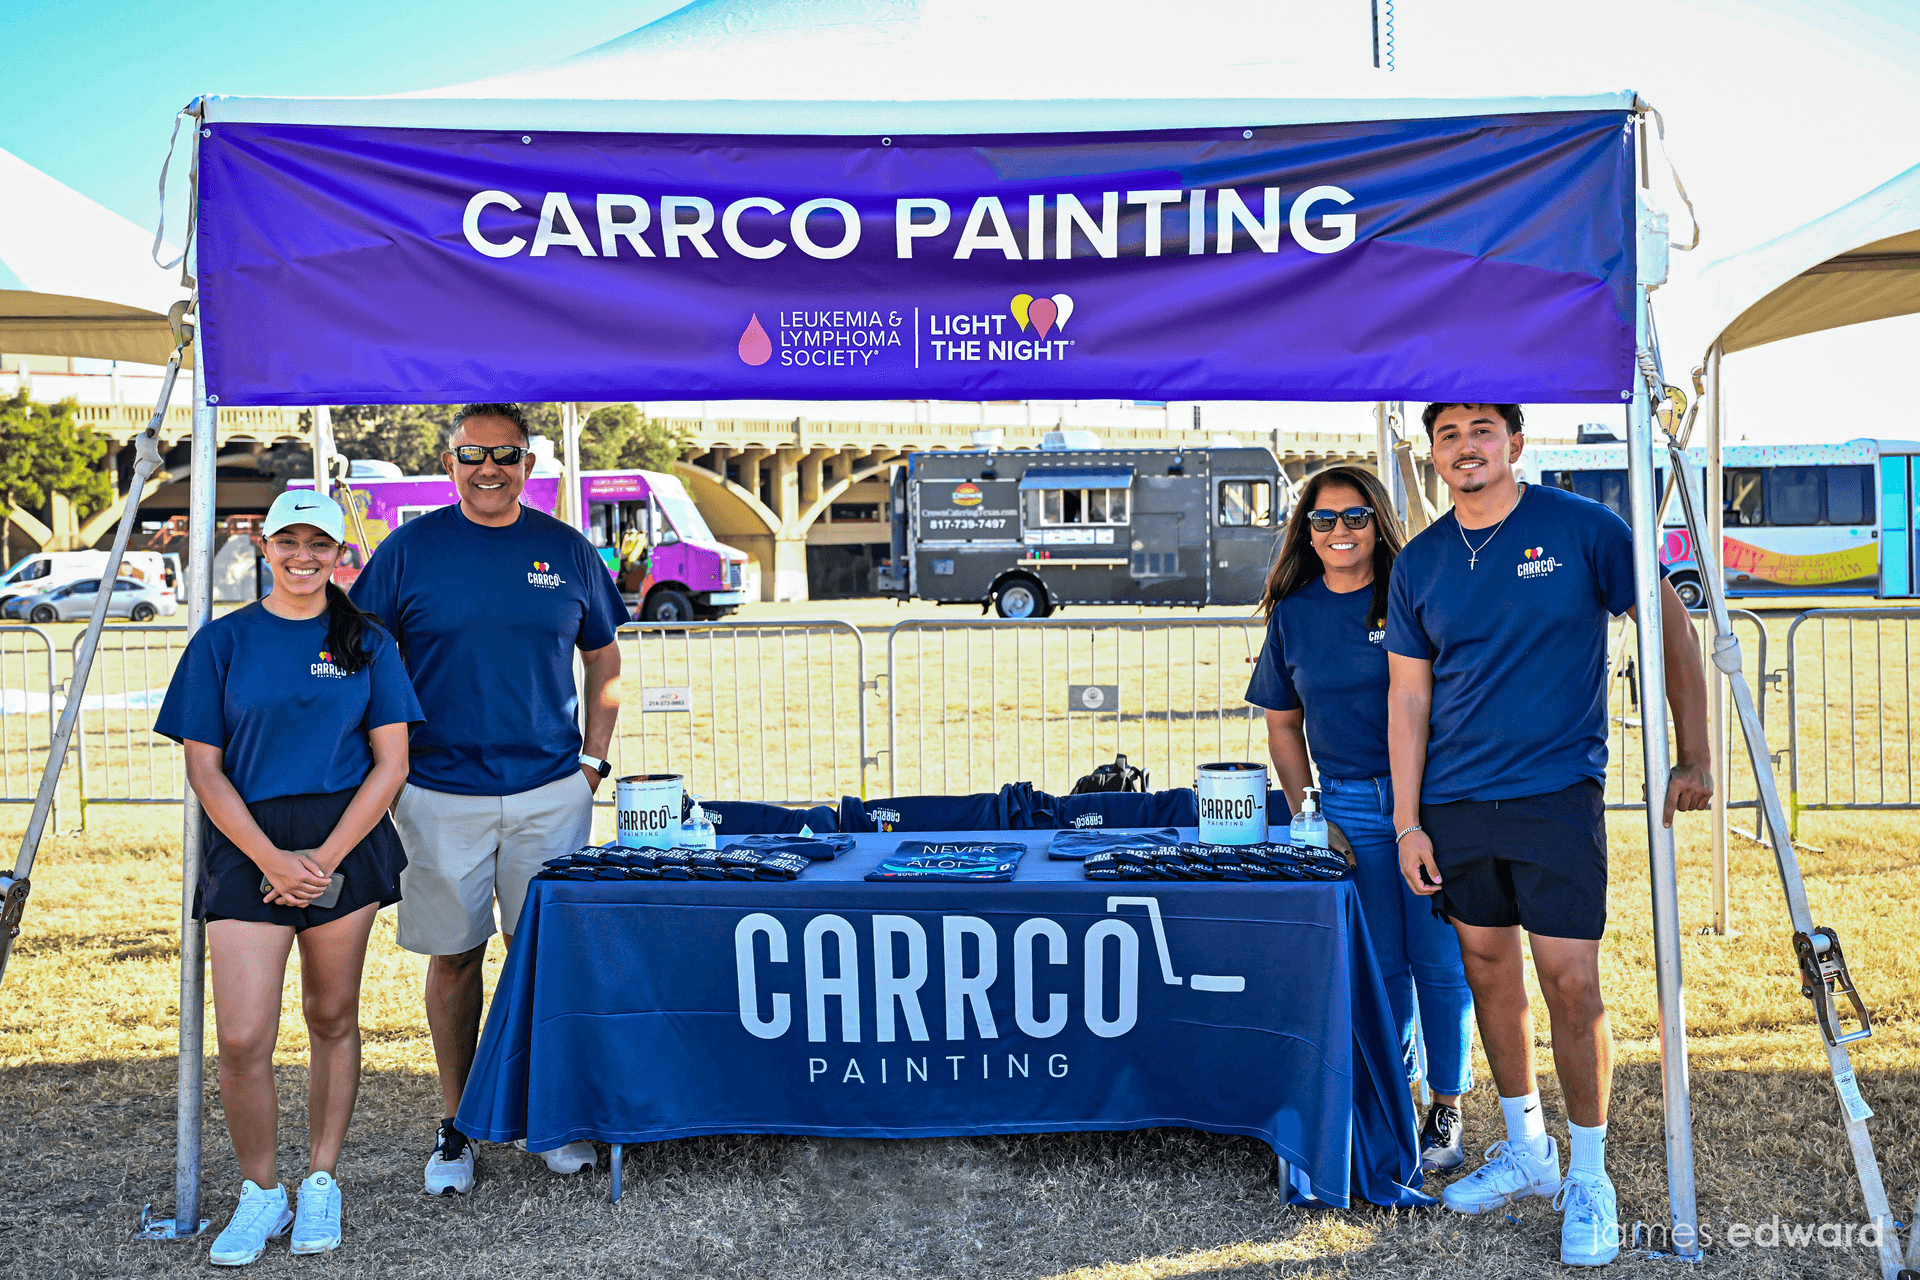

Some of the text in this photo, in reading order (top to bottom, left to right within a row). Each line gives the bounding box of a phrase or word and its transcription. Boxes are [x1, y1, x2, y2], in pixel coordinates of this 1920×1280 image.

[462, 185, 1357, 260] CARRCO PAINTING
[780, 311, 902, 328] LEUKEMIA &
[930, 314, 1007, 335] LIGHT
[780, 330, 902, 347] LYMPHOMA
[931, 340, 981, 361] THE
[930, 519, 1006, 529] 817-739-7497
[1517, 559, 1554, 577] CARRCO
[527, 572, 559, 587] CARRCO
[1201, 798, 1253, 820] CARRCO
[618, 809, 667, 831] CARRCO
[922, 844, 997, 854] NEVER
[734, 912, 1139, 1043] CARRCO
[809, 1053, 1069, 1084] PAINTING
